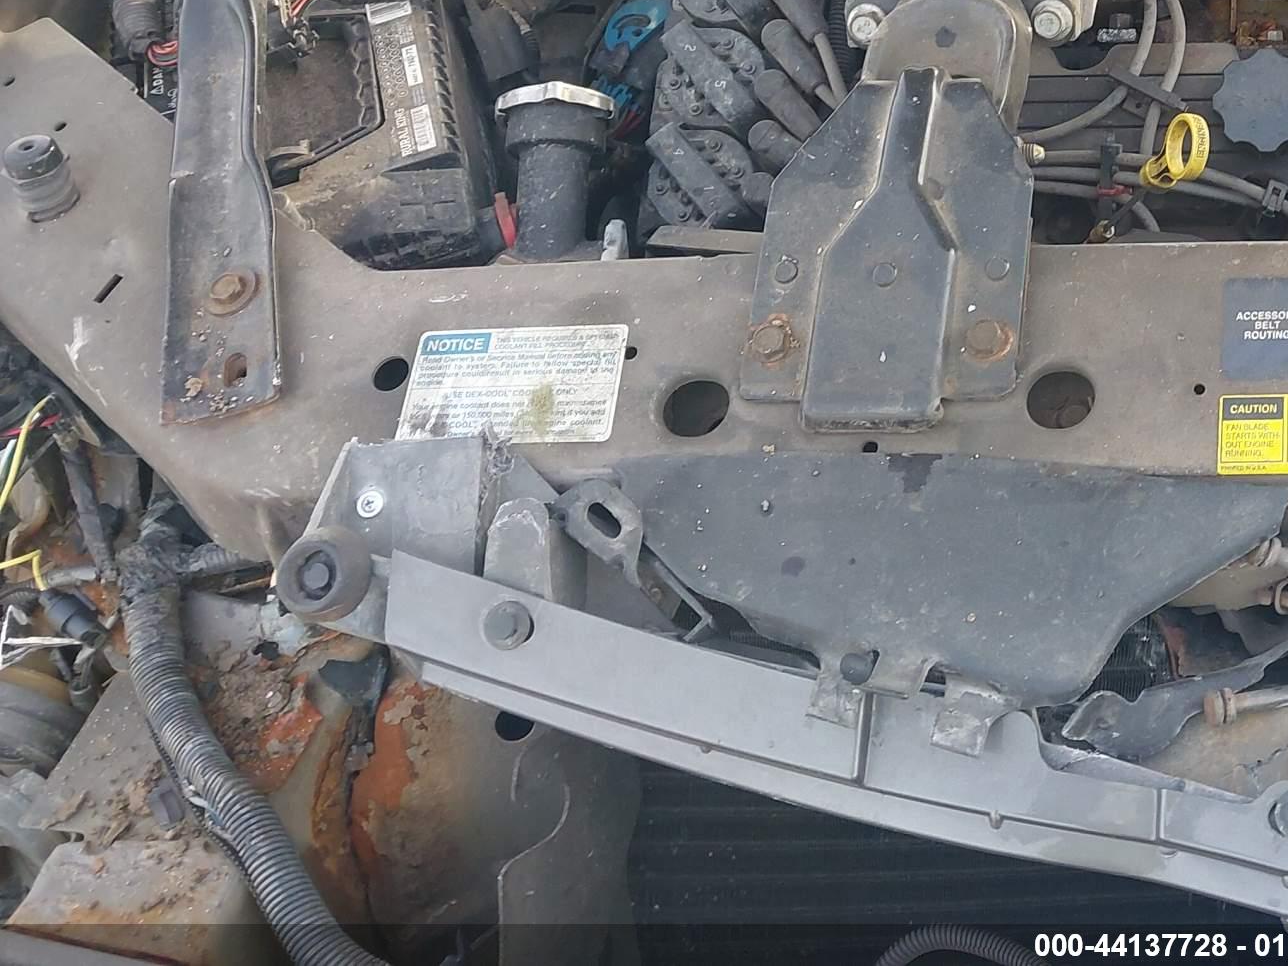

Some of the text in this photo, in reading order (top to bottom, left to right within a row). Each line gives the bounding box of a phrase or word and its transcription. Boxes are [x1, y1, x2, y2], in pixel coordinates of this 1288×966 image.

[684, 44, 726, 90] 2 5
[394, 108, 408, 128] KING
[1254, 321, 1280, 330] BELT
[426, 338, 486, 352] NOTICE
[444, 354, 475, 362] Owner's
[420, 363, 452, 371] coolant
[1230, 404, 1278, 414] CAUTION
